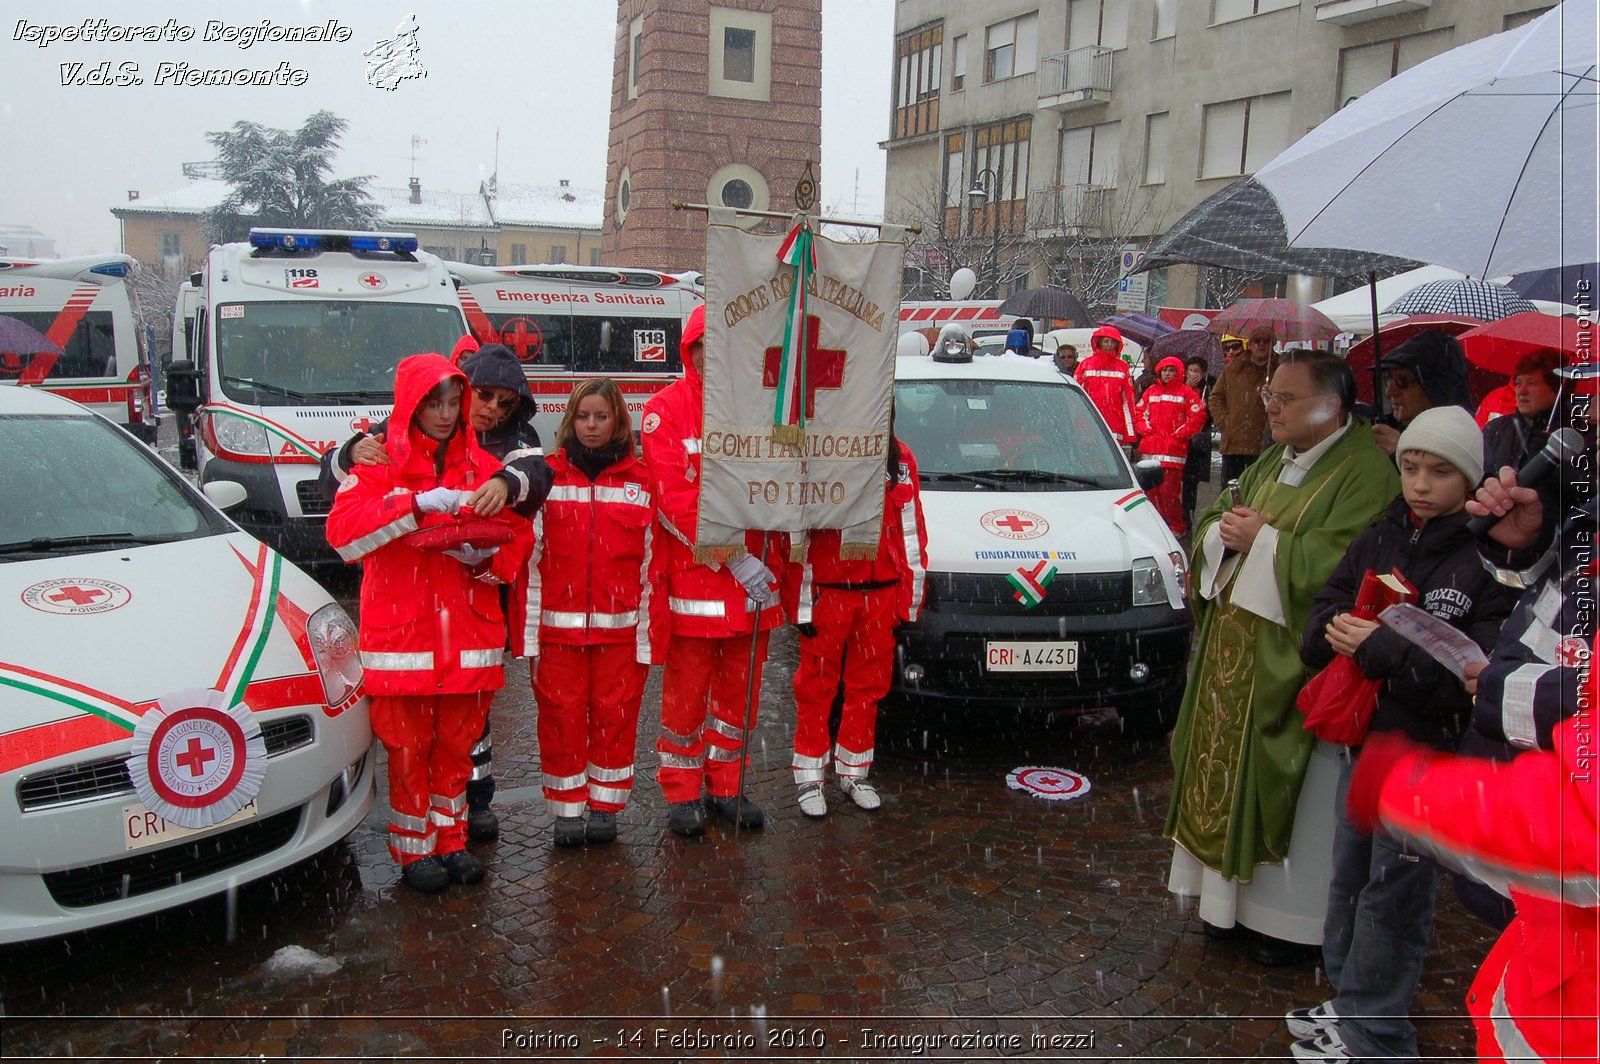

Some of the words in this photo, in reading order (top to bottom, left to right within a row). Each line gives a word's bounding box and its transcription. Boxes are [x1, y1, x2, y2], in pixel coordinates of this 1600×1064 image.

[289, 269, 318, 278] 118
[0, 284, 36, 297] aria
[495, 289, 590, 304] Emergenza
[594, 292, 666, 305] Sanitaria
[724, 284, 770, 328] CROCE
[770, 272, 818, 302] ROA
[639, 331, 665, 345] 118
[542, 403, 567, 413] ROSS
[627, 402, 645, 411] OIR
[812, 434, 883, 458] LOCALE
[975, 551, 1041, 560] FONDAZIONE
[1057, 551, 1077, 560] CRT
[70, 603, 114, 613] POIRINO
[1424, 588, 1473, 614] BOXEUR
[1440, 602, 1465, 617] RUES
[988, 648, 1014, 665] CRI
[1023, 648, 1077, 665] A443D
[176, 721, 217, 736] GINEVRA
[214, 729, 226, 741] 22
[167, 732, 179, 744] DI
[218, 741, 232, 775] AGOSTO
[160, 744, 195, 795] CONVENZIONE
